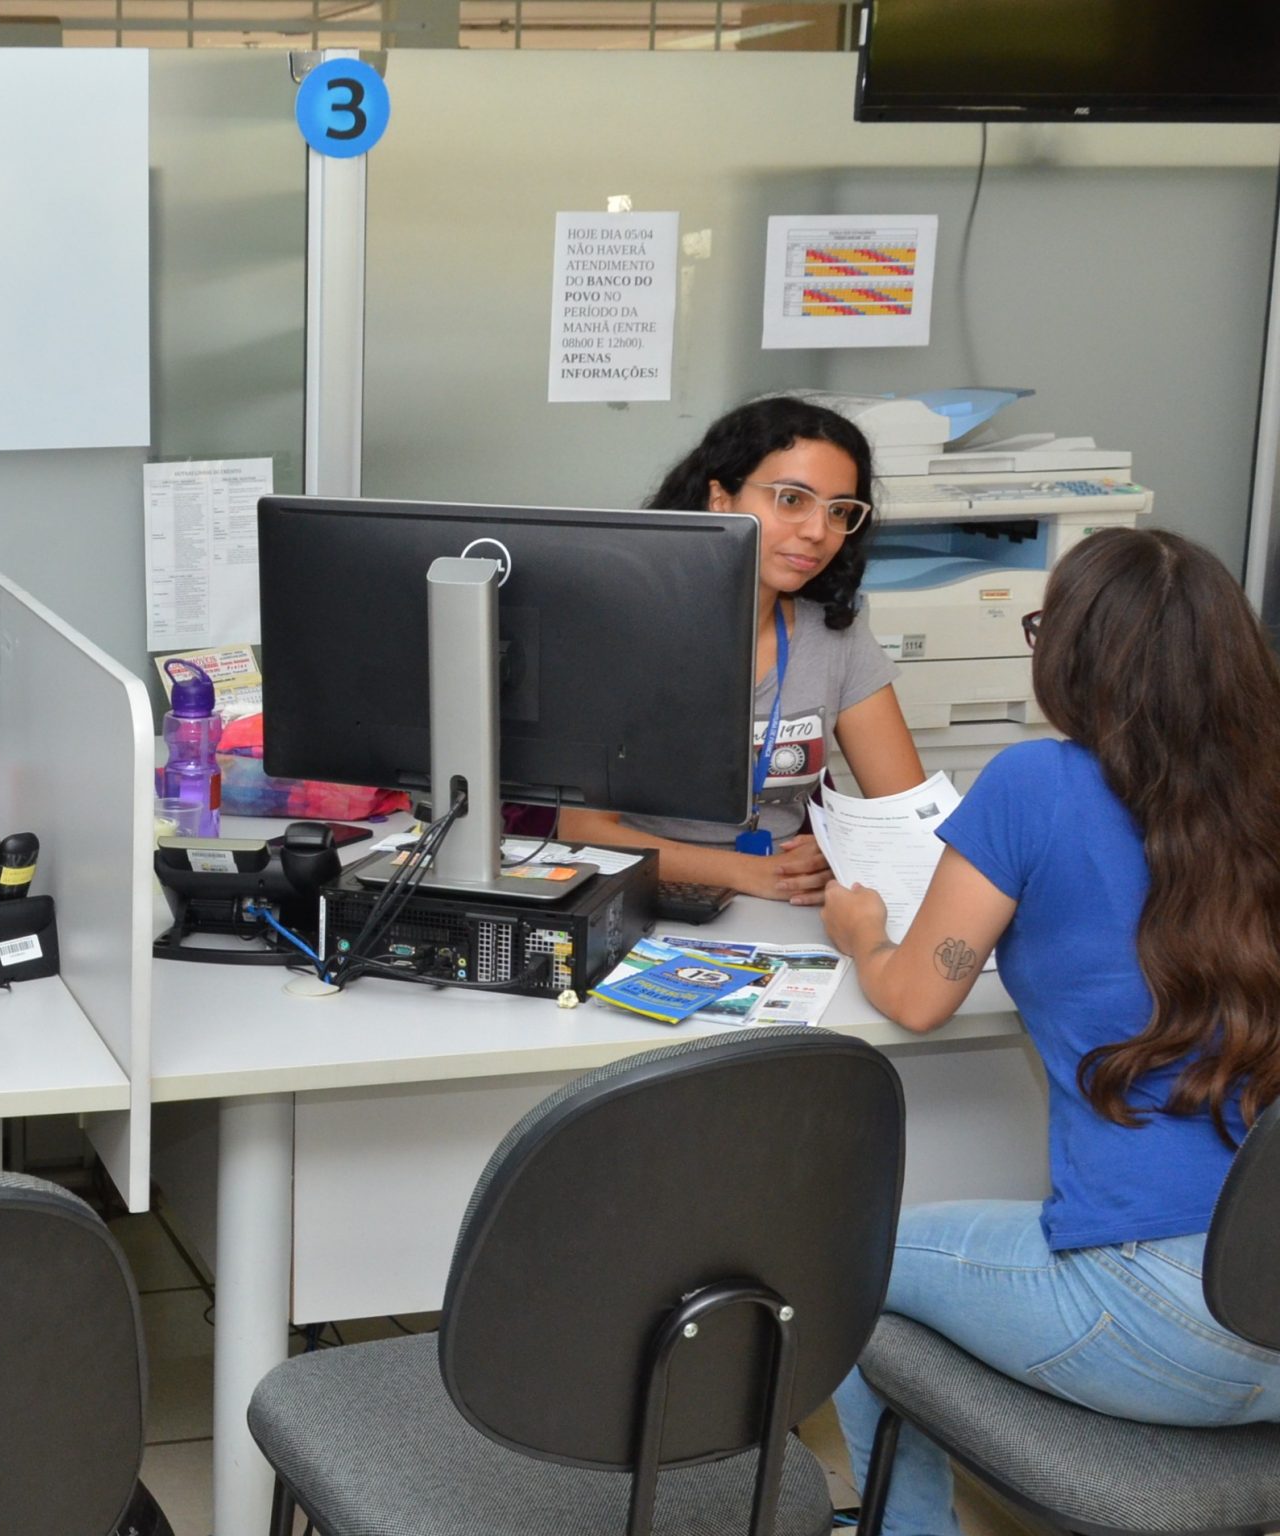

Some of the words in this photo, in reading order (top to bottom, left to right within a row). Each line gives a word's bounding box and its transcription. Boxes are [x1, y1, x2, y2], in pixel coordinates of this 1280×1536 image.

[325, 77, 367, 140] 3
[567, 228, 598, 240] HOJE
[600, 228, 622, 240] DIA
[624, 228, 654, 240] 05/04
[566, 242, 594, 255] NÃO
[596, 242, 647, 255] HAVERÁ
[565, 260, 655, 271] ATENDIMENTO
[565, 275, 584, 287] DO
[586, 275, 631, 287] BANCO
[634, 275, 653, 287] DO
[564, 291, 600, 302] POVO
[603, 291, 622, 302] NO
[563, 304, 618, 317] PERÍODO
[621, 306, 638, 317] DA
[562, 320, 610, 333] MANHÃ
[612, 321, 657, 335] (ENTRE
[561, 337, 594, 348] 08h00
[596, 337, 604, 348] E
[561, 353, 612, 363] APENAS
[561, 365, 659, 380] INFORMAÇÕES!
[780, 722, 813, 739] 1970
